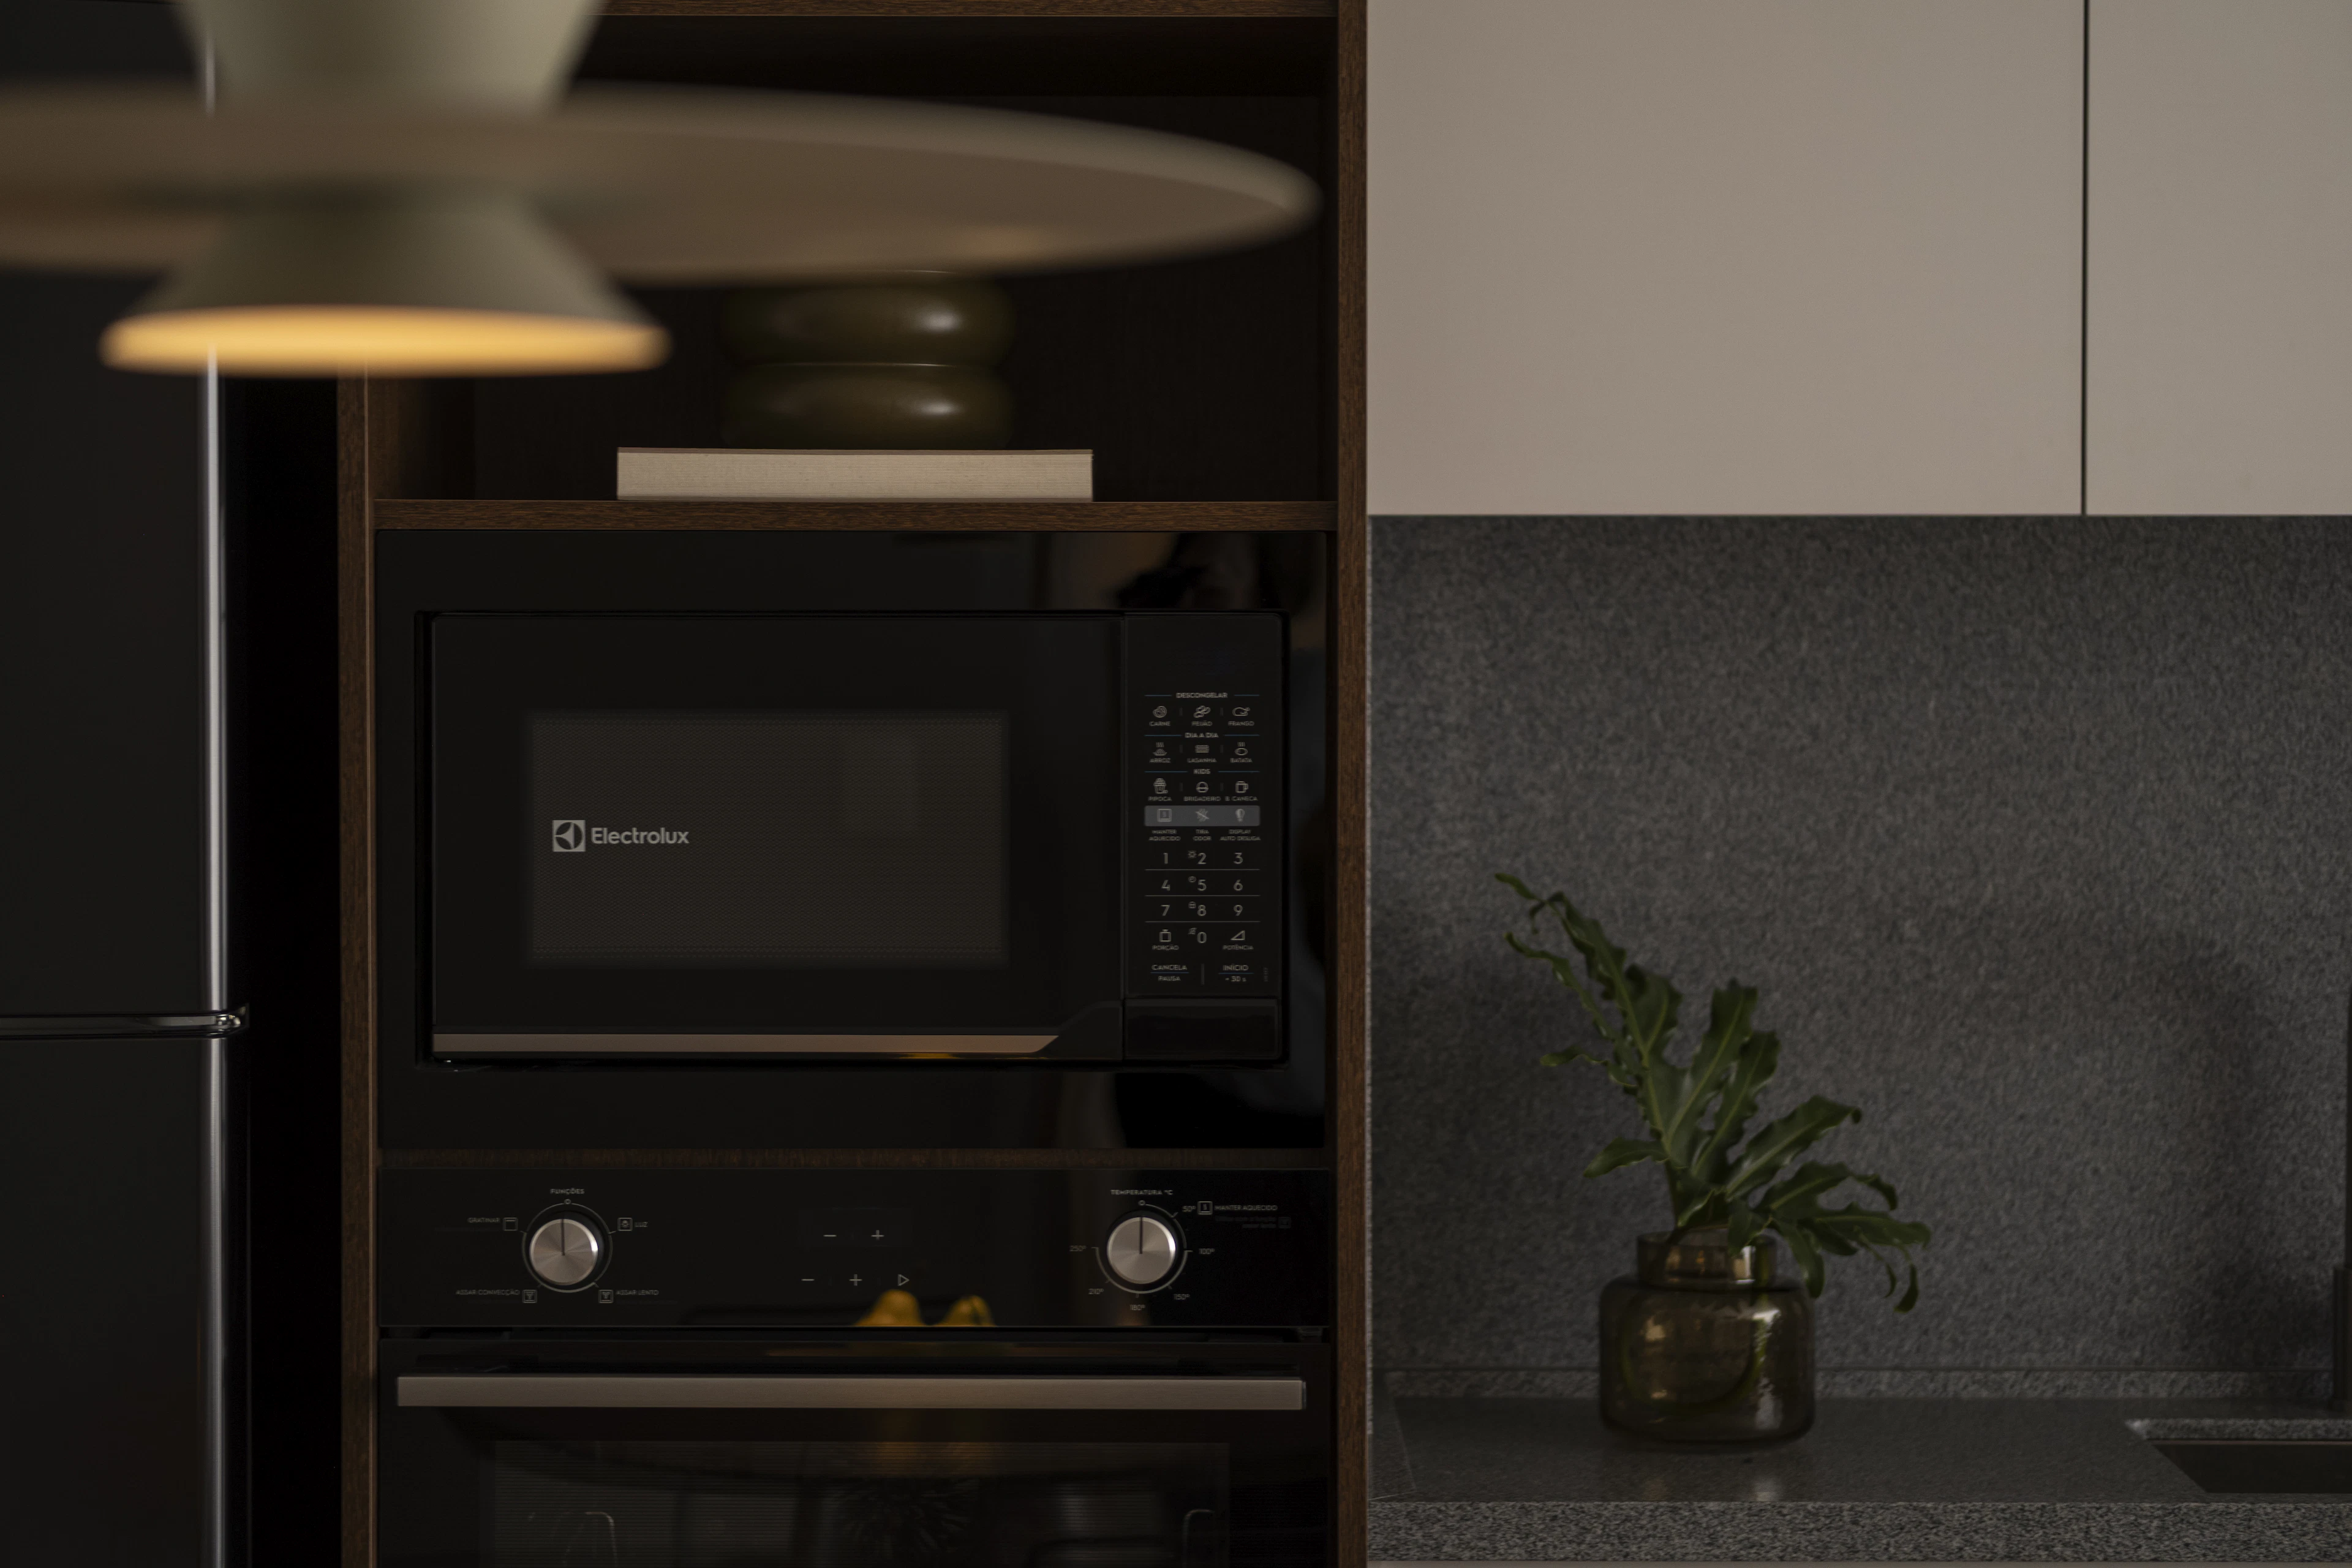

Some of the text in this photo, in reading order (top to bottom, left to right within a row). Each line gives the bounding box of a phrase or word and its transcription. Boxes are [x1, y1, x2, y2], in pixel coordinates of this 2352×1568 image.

[591, 827, 690, 844] Electrolux
[1163, 853, 1169, 864] 1
[1197, 853, 1207, 865] 2
[1234, 852, 1243, 864] 3
[1161, 880, 1170, 891] 4
[1197, 879, 1207, 891] 5
[1234, 879, 1243, 891] 6
[1161, 904, 1170, 916] 7
[1197, 904, 1207, 916] 8
[1234, 904, 1243, 916] 9
[1197, 932, 1207, 943] 0
